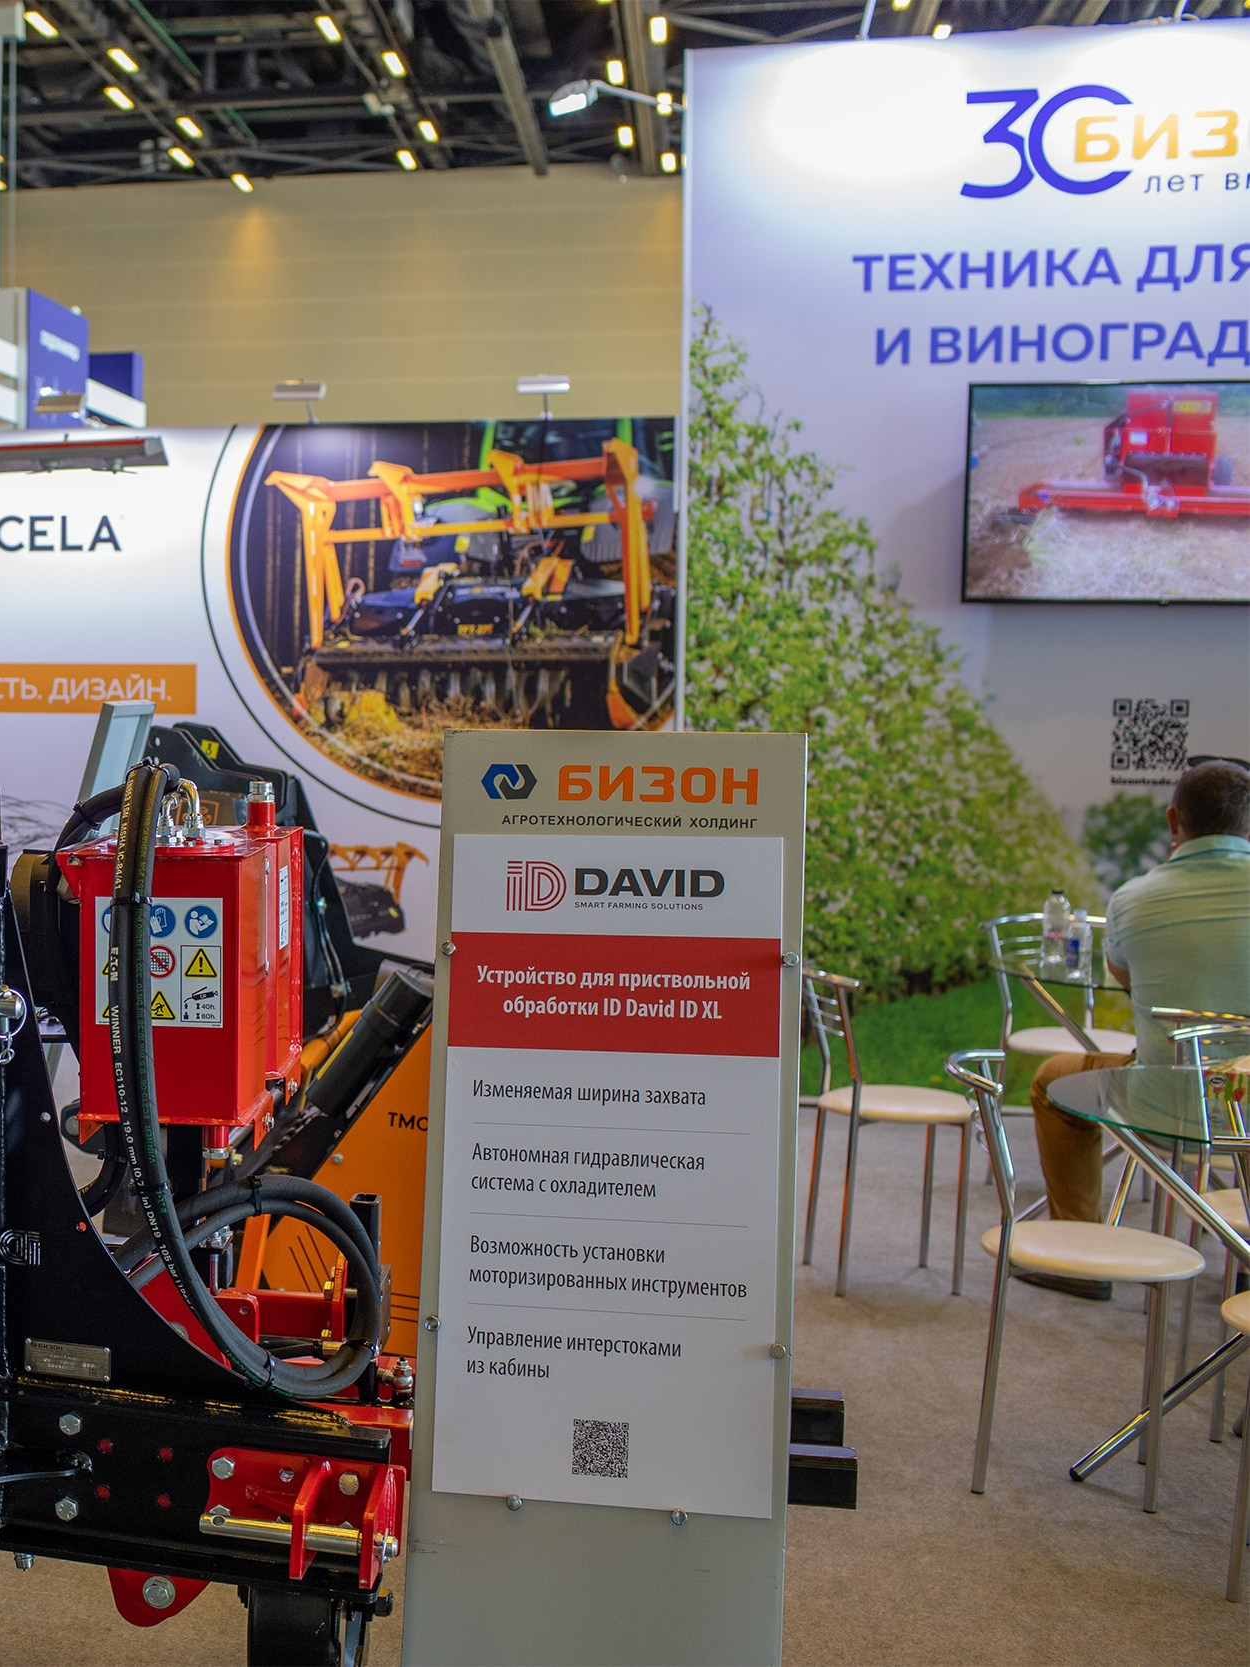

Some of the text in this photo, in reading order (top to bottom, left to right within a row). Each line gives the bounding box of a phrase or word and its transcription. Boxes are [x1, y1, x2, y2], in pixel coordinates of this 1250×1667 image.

[1074, 109, 1250, 163] БИЗ
[1144, 174, 1205, 193] лет
[852, 243, 1250, 293] ТЕХНИКА ДЛЯ
[875, 319, 1250, 367] И ВИНОГРАД
[48, 674, 172, 703] ДИЗАЙН.
[558, 765, 759, 805] БИЗОН
[501, 814, 757, 831] АГРОТЕХНОЛОГИЧЕСКИЙ ХОЛДИНГ
[574, 867, 725, 898] DAVID
[574, 901, 703, 911] SMART FARMING SOLUTIONS
[477, 965, 751, 993] Устройство для приствольной
[502, 998, 722, 1019] обработки ID David ID XL
[111, 1005, 122, 1054] WINNER
[114, 1062, 128, 1113] EC110-12
[473, 1079, 706, 1109] Изменяемая ширина захвата
[123, 1120, 134, 1144] 19.0
[129, 1146, 138, 1165] mm
[472, 1143, 705, 1171] Автономная гидравлическая
[471, 1175, 657, 1199] система с охладителем
[146, 1211, 162, 1238] DN19
[159, 1243, 172, 1264] 105
[470, 1235, 665, 1264] Возможность установки
[168, 1262, 178, 1279] bar
[468, 1268, 747, 1300] моторизированных инструментов
[467, 1326, 682, 1358] Управление интерстоками
[466, 1358, 550, 1379] из кабины
